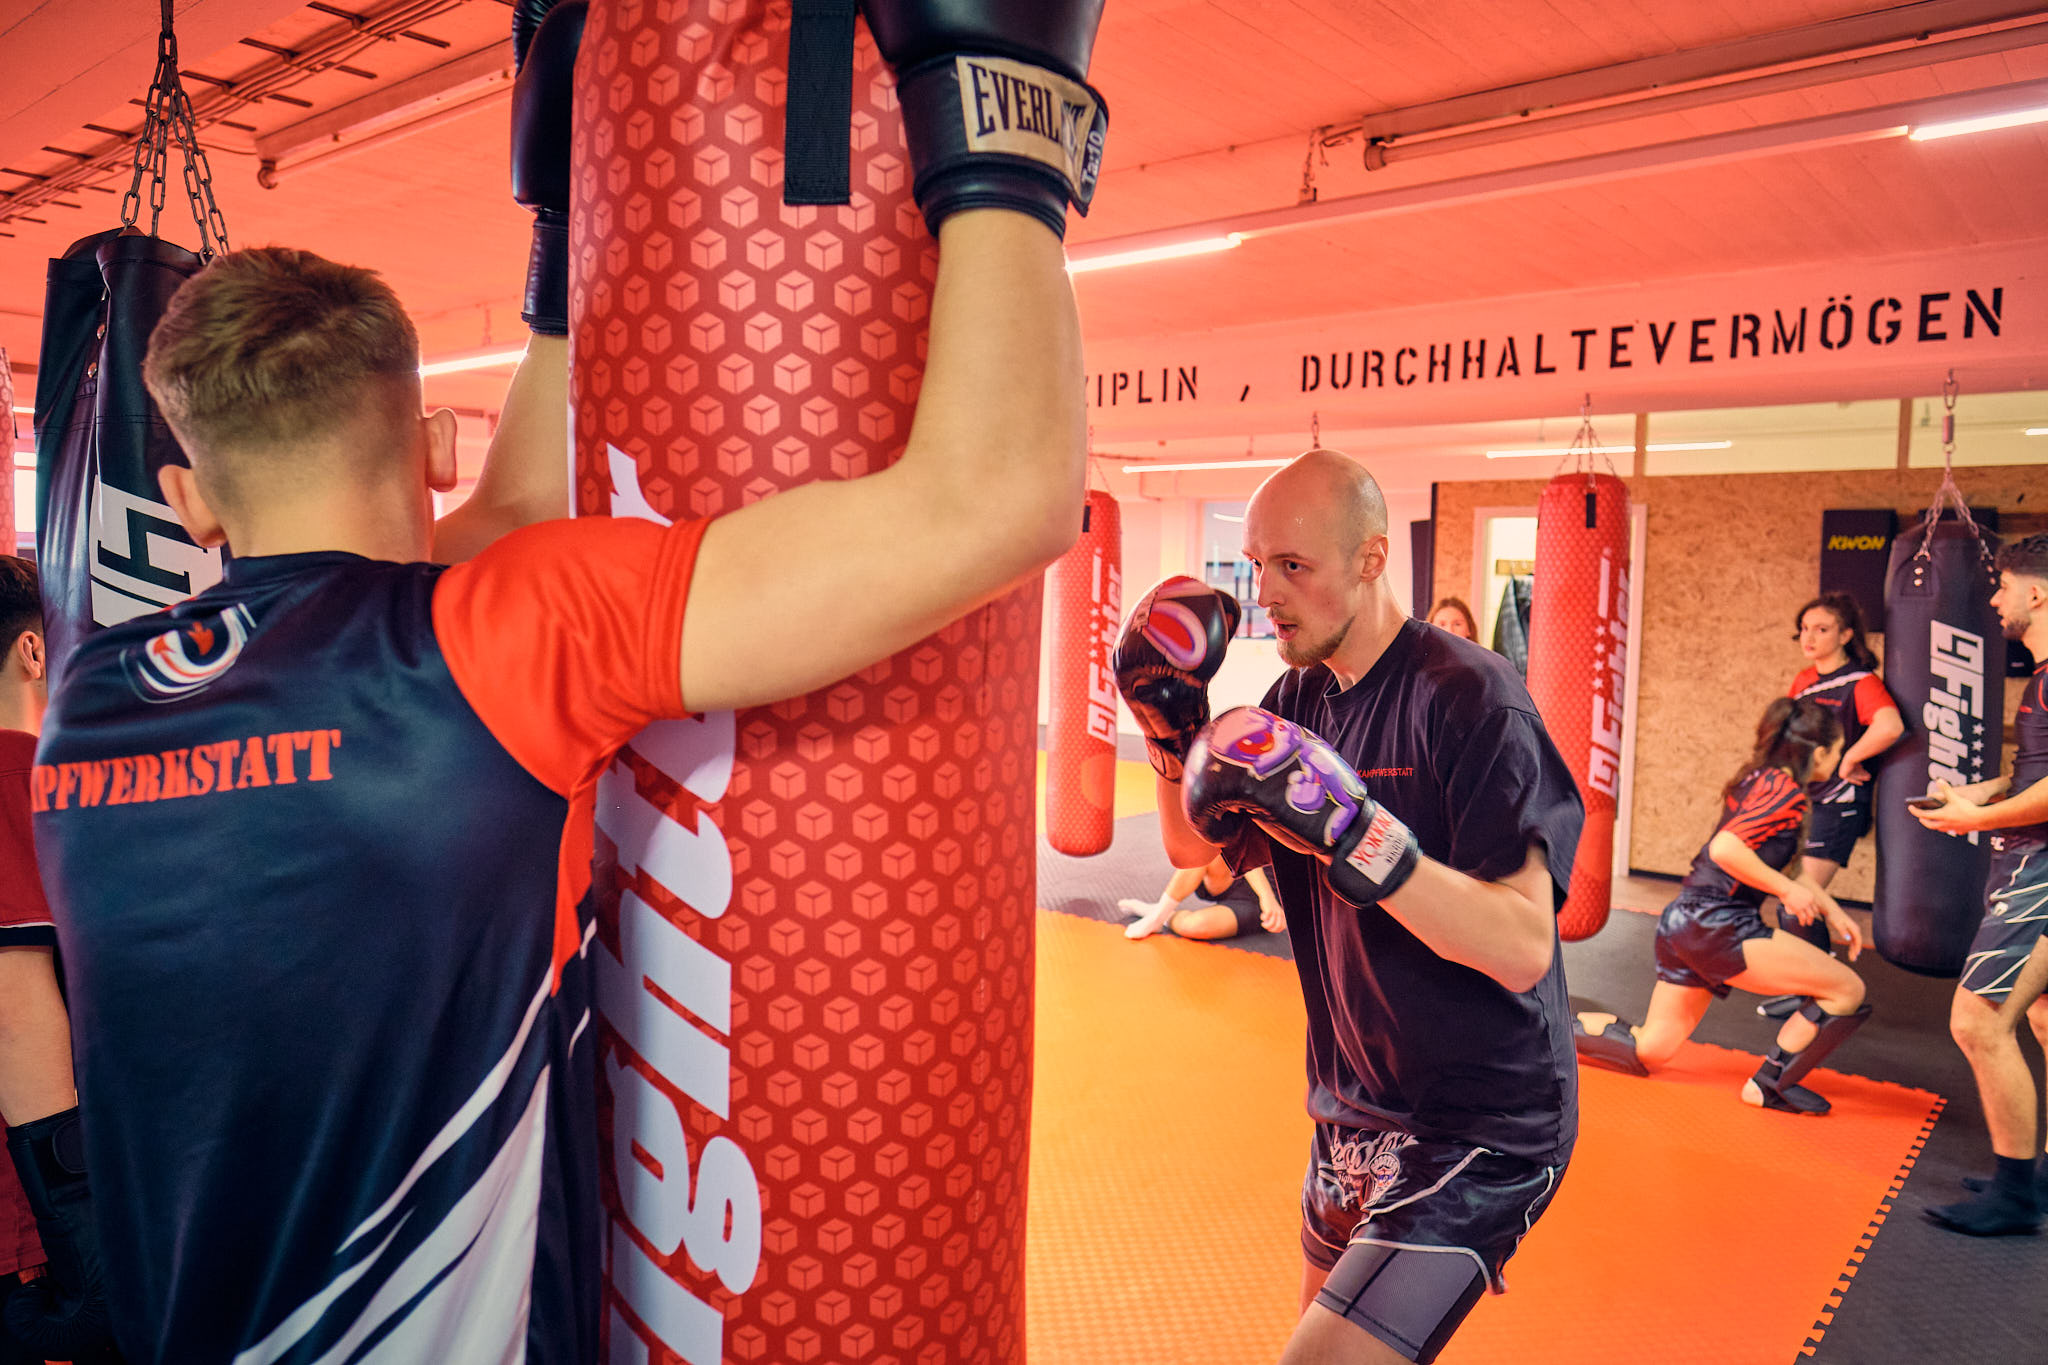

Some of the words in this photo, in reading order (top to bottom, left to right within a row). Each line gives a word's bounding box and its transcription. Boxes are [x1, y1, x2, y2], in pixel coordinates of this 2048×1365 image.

[967, 62, 1086, 144] EVERLT
[1085, 366, 1197, 408] IPLIN
[1302, 287, 2004, 392] DURCHHALTEVERMÖGEN
[1828, 535, 1886, 551] KWON
[1923, 619, 1984, 838] 4Fight
